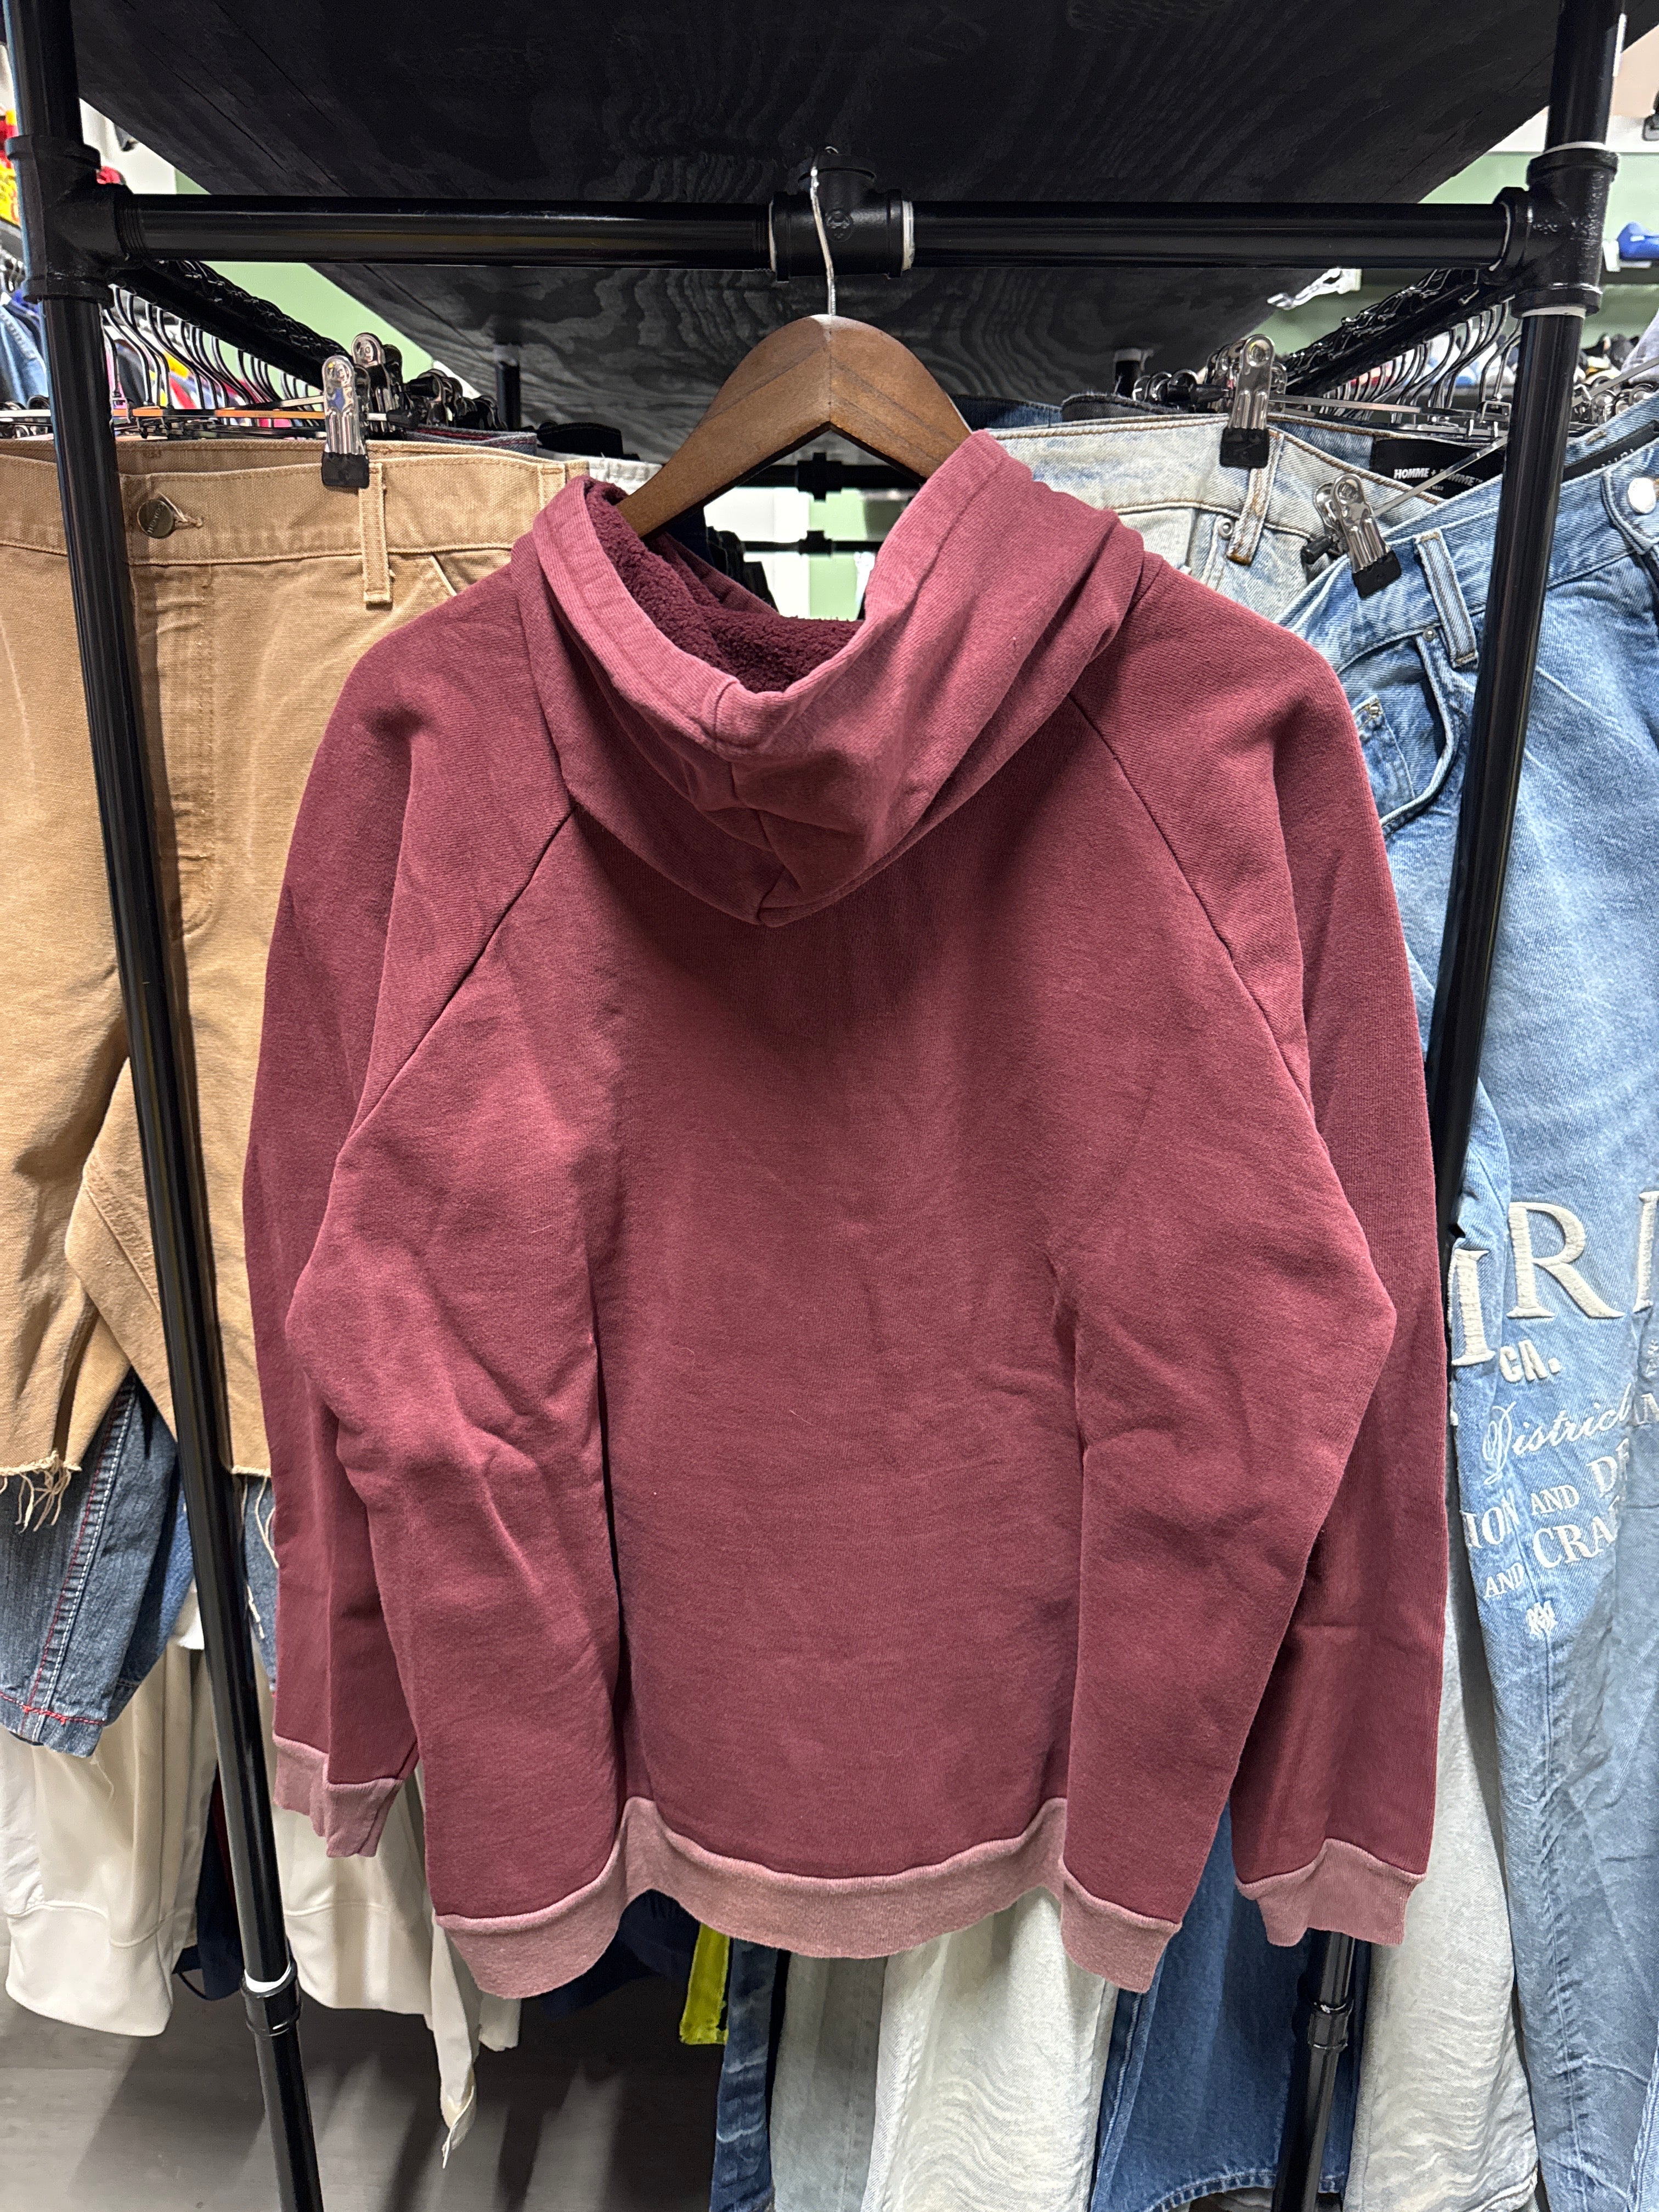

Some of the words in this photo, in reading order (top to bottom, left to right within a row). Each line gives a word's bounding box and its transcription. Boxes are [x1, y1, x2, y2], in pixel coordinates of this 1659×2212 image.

[1393, 468, 1430, 479] HOMME
[1531, 1484, 1580, 1516] AND
[1483, 1561, 1525, 1599] AND
